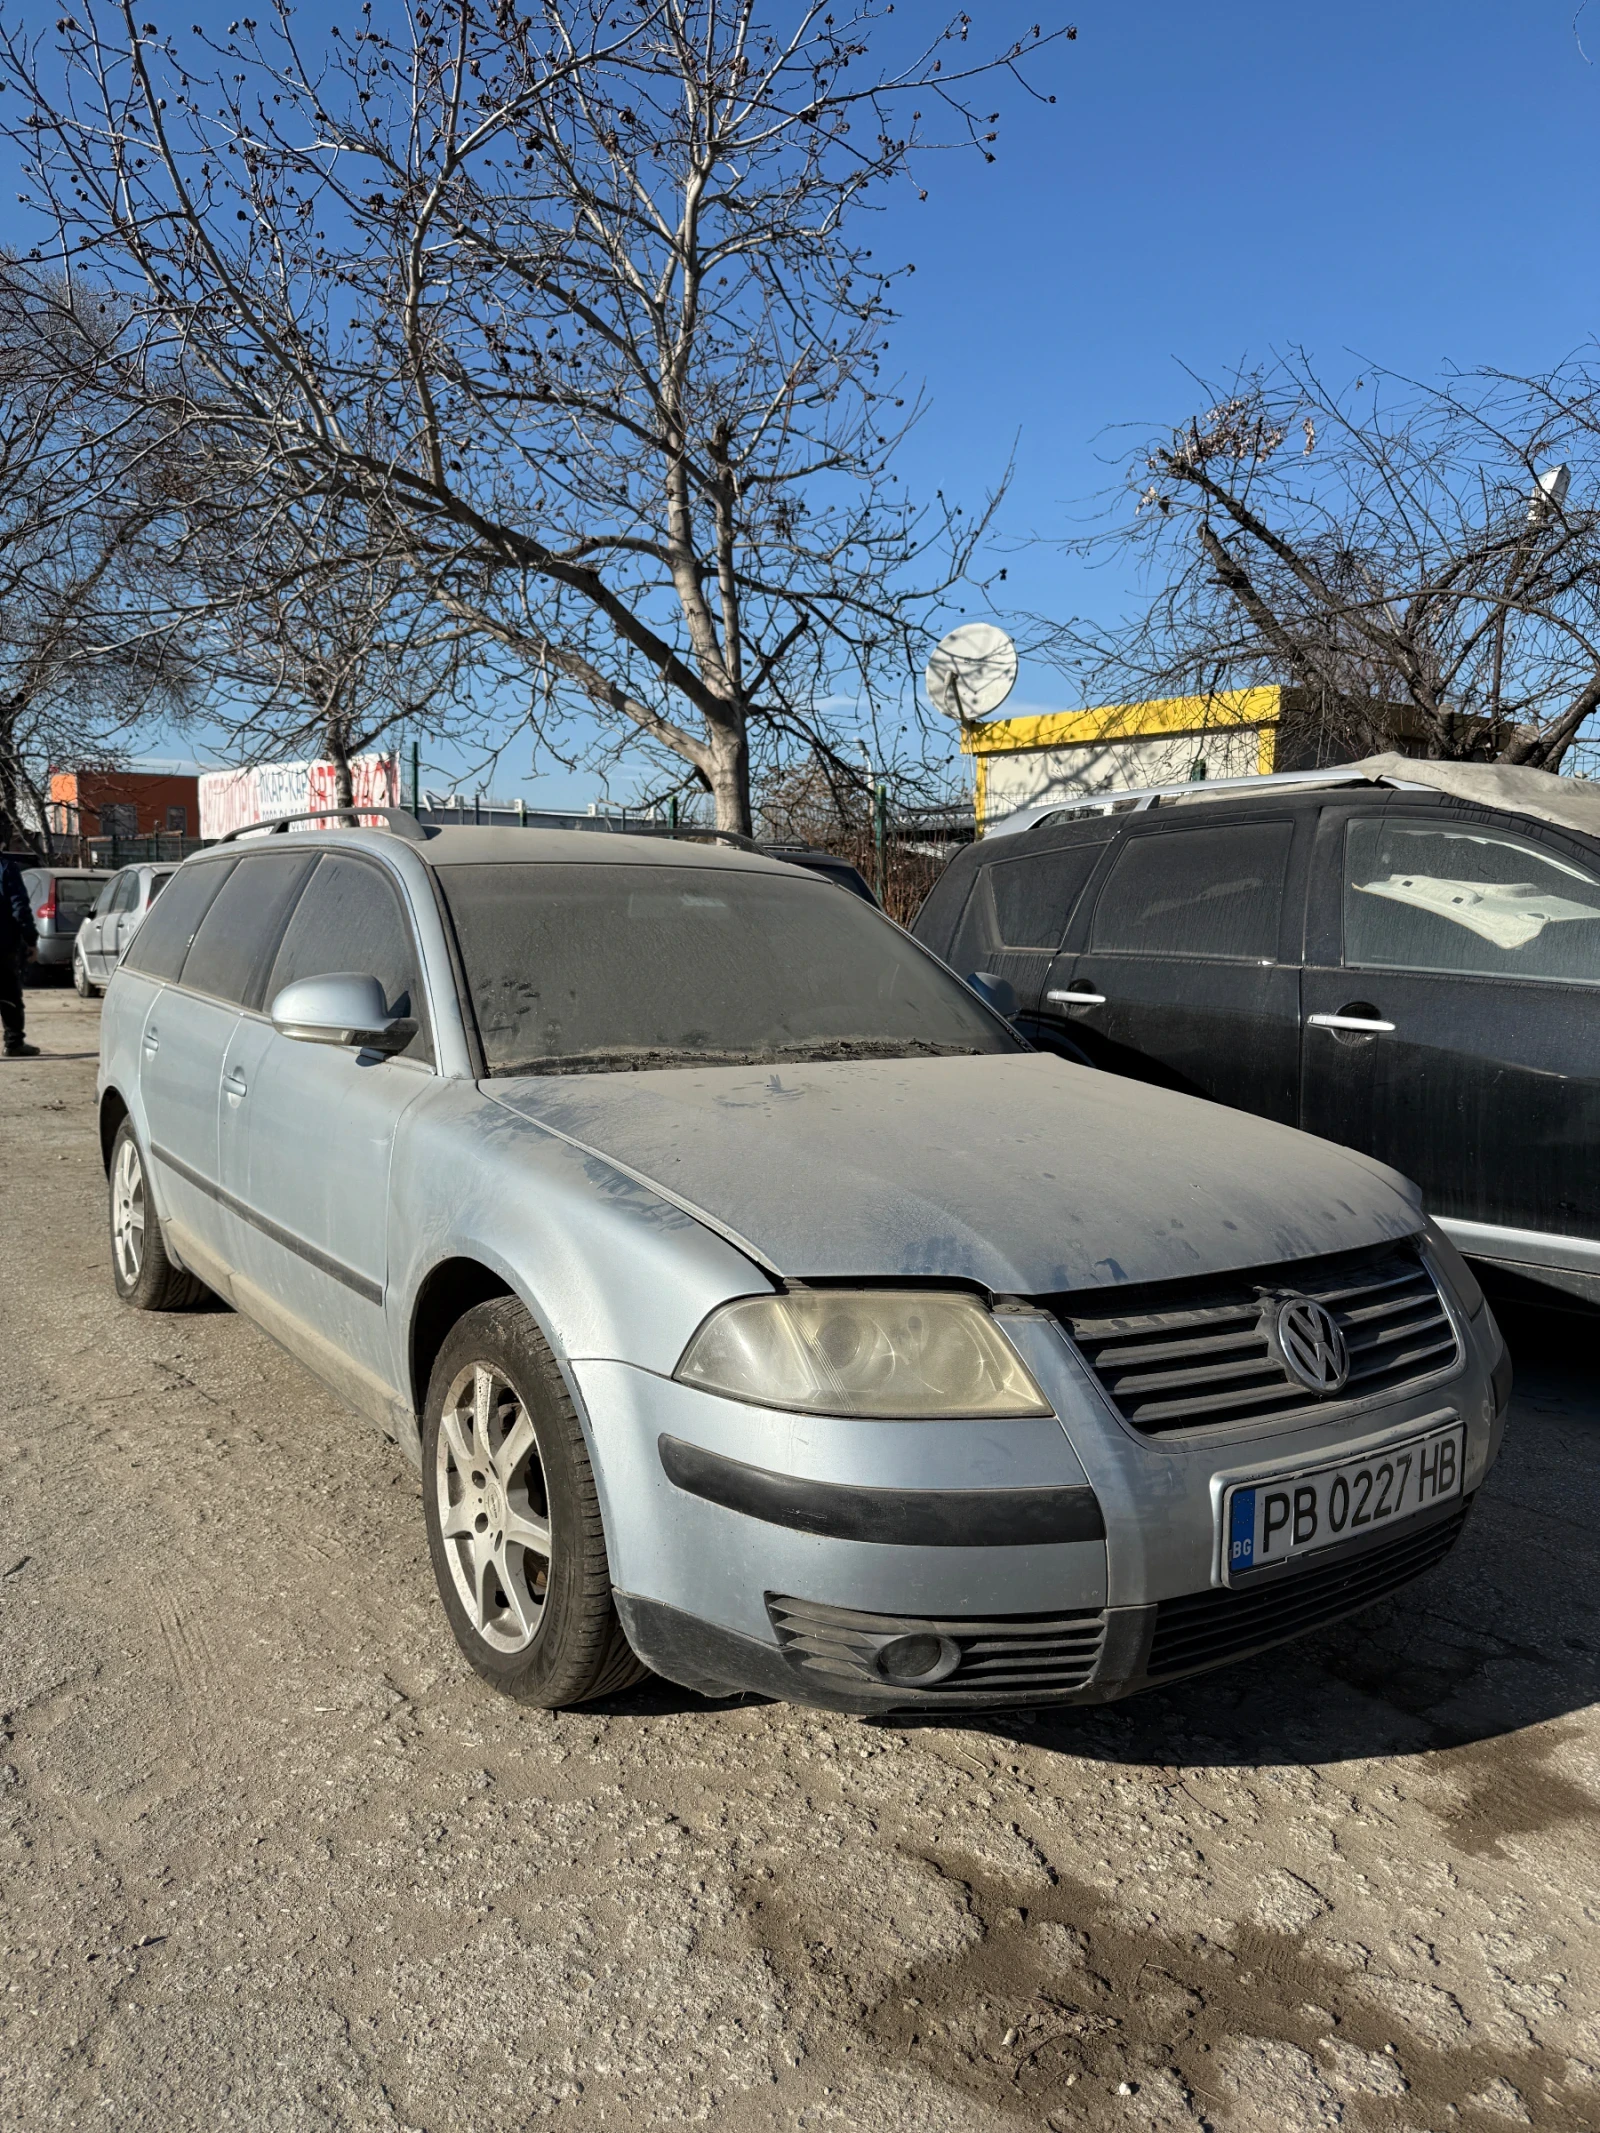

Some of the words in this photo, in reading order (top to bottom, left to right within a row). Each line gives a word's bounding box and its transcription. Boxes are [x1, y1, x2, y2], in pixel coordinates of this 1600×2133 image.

[1278, 1298, 1350, 1392] VW
[1263, 1486, 1318, 1553] PB
[1328, 1454, 1412, 1533] 0227
[1418, 1438, 1456, 1503] HB
[1233, 1538, 1252, 1559] BG
